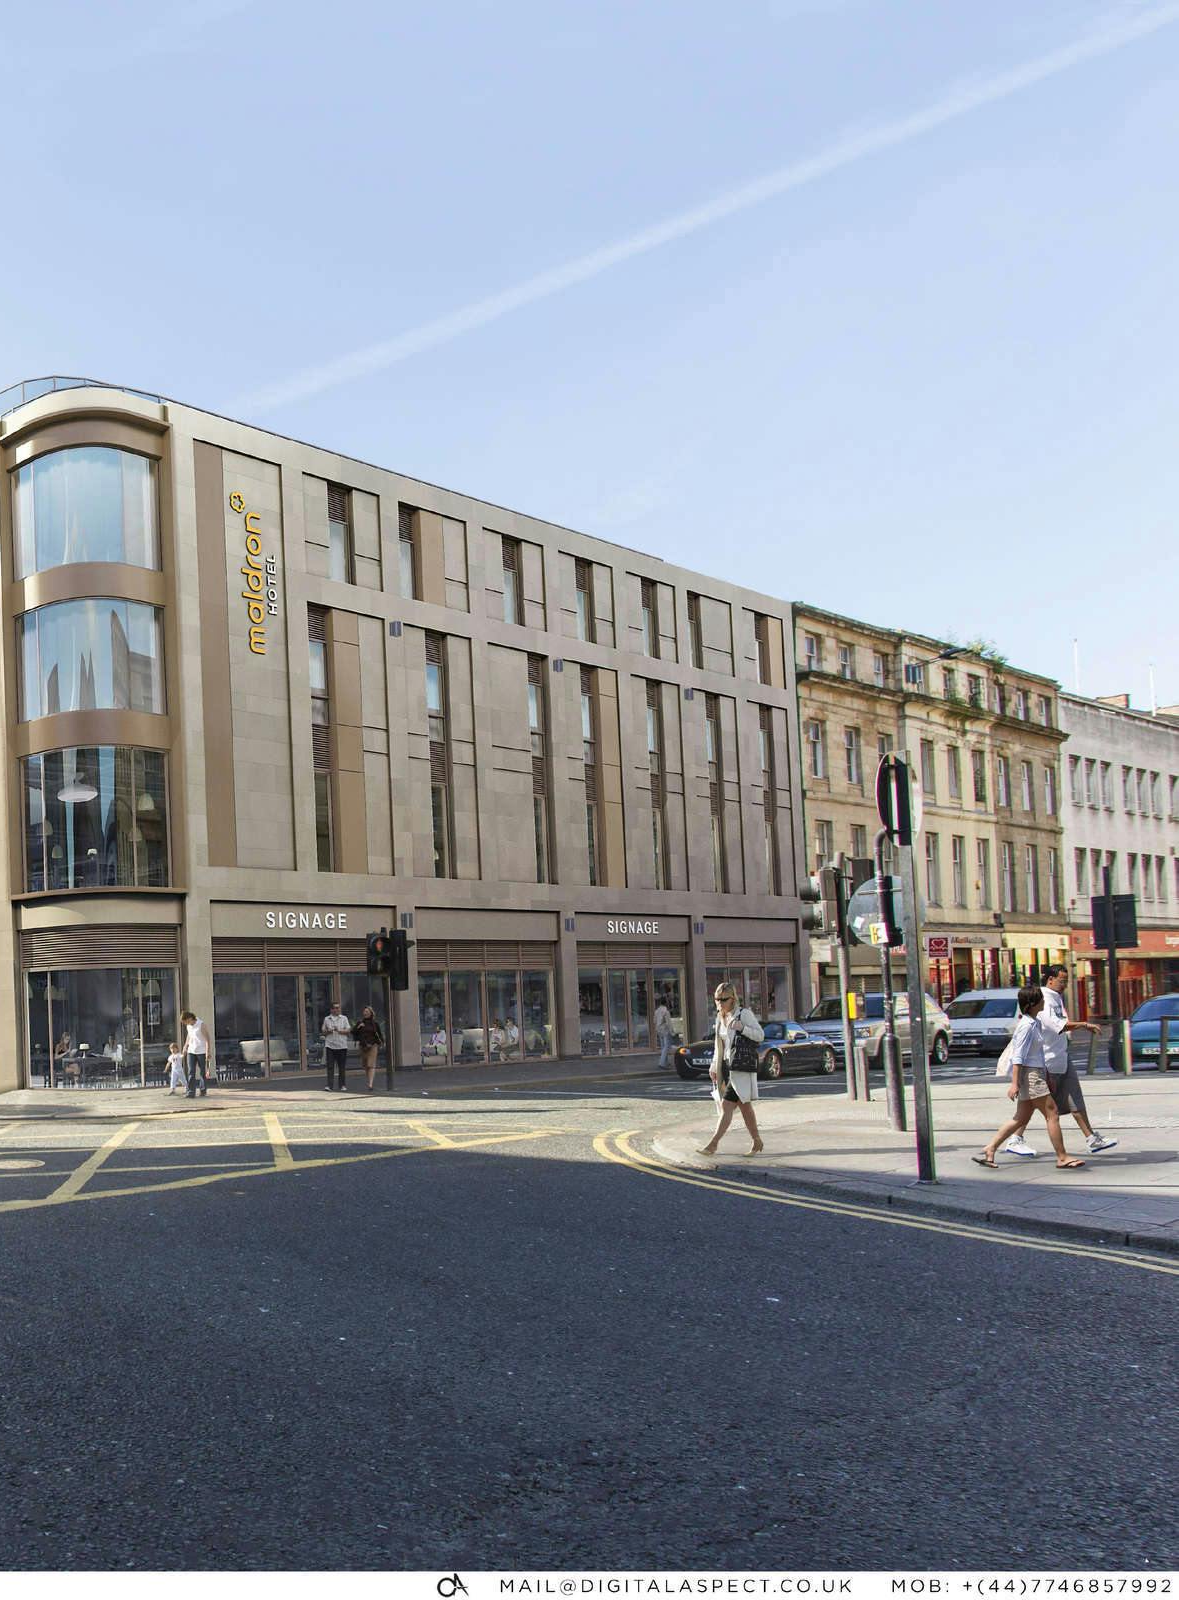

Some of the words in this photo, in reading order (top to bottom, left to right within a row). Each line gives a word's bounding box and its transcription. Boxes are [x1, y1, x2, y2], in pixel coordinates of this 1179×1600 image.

[240, 510, 268, 656] maldron
[266, 554, 278, 616] HOTEL
[265, 911, 348, 929] SIGNAGE
[607, 920, 660, 935] SIGNAGE
